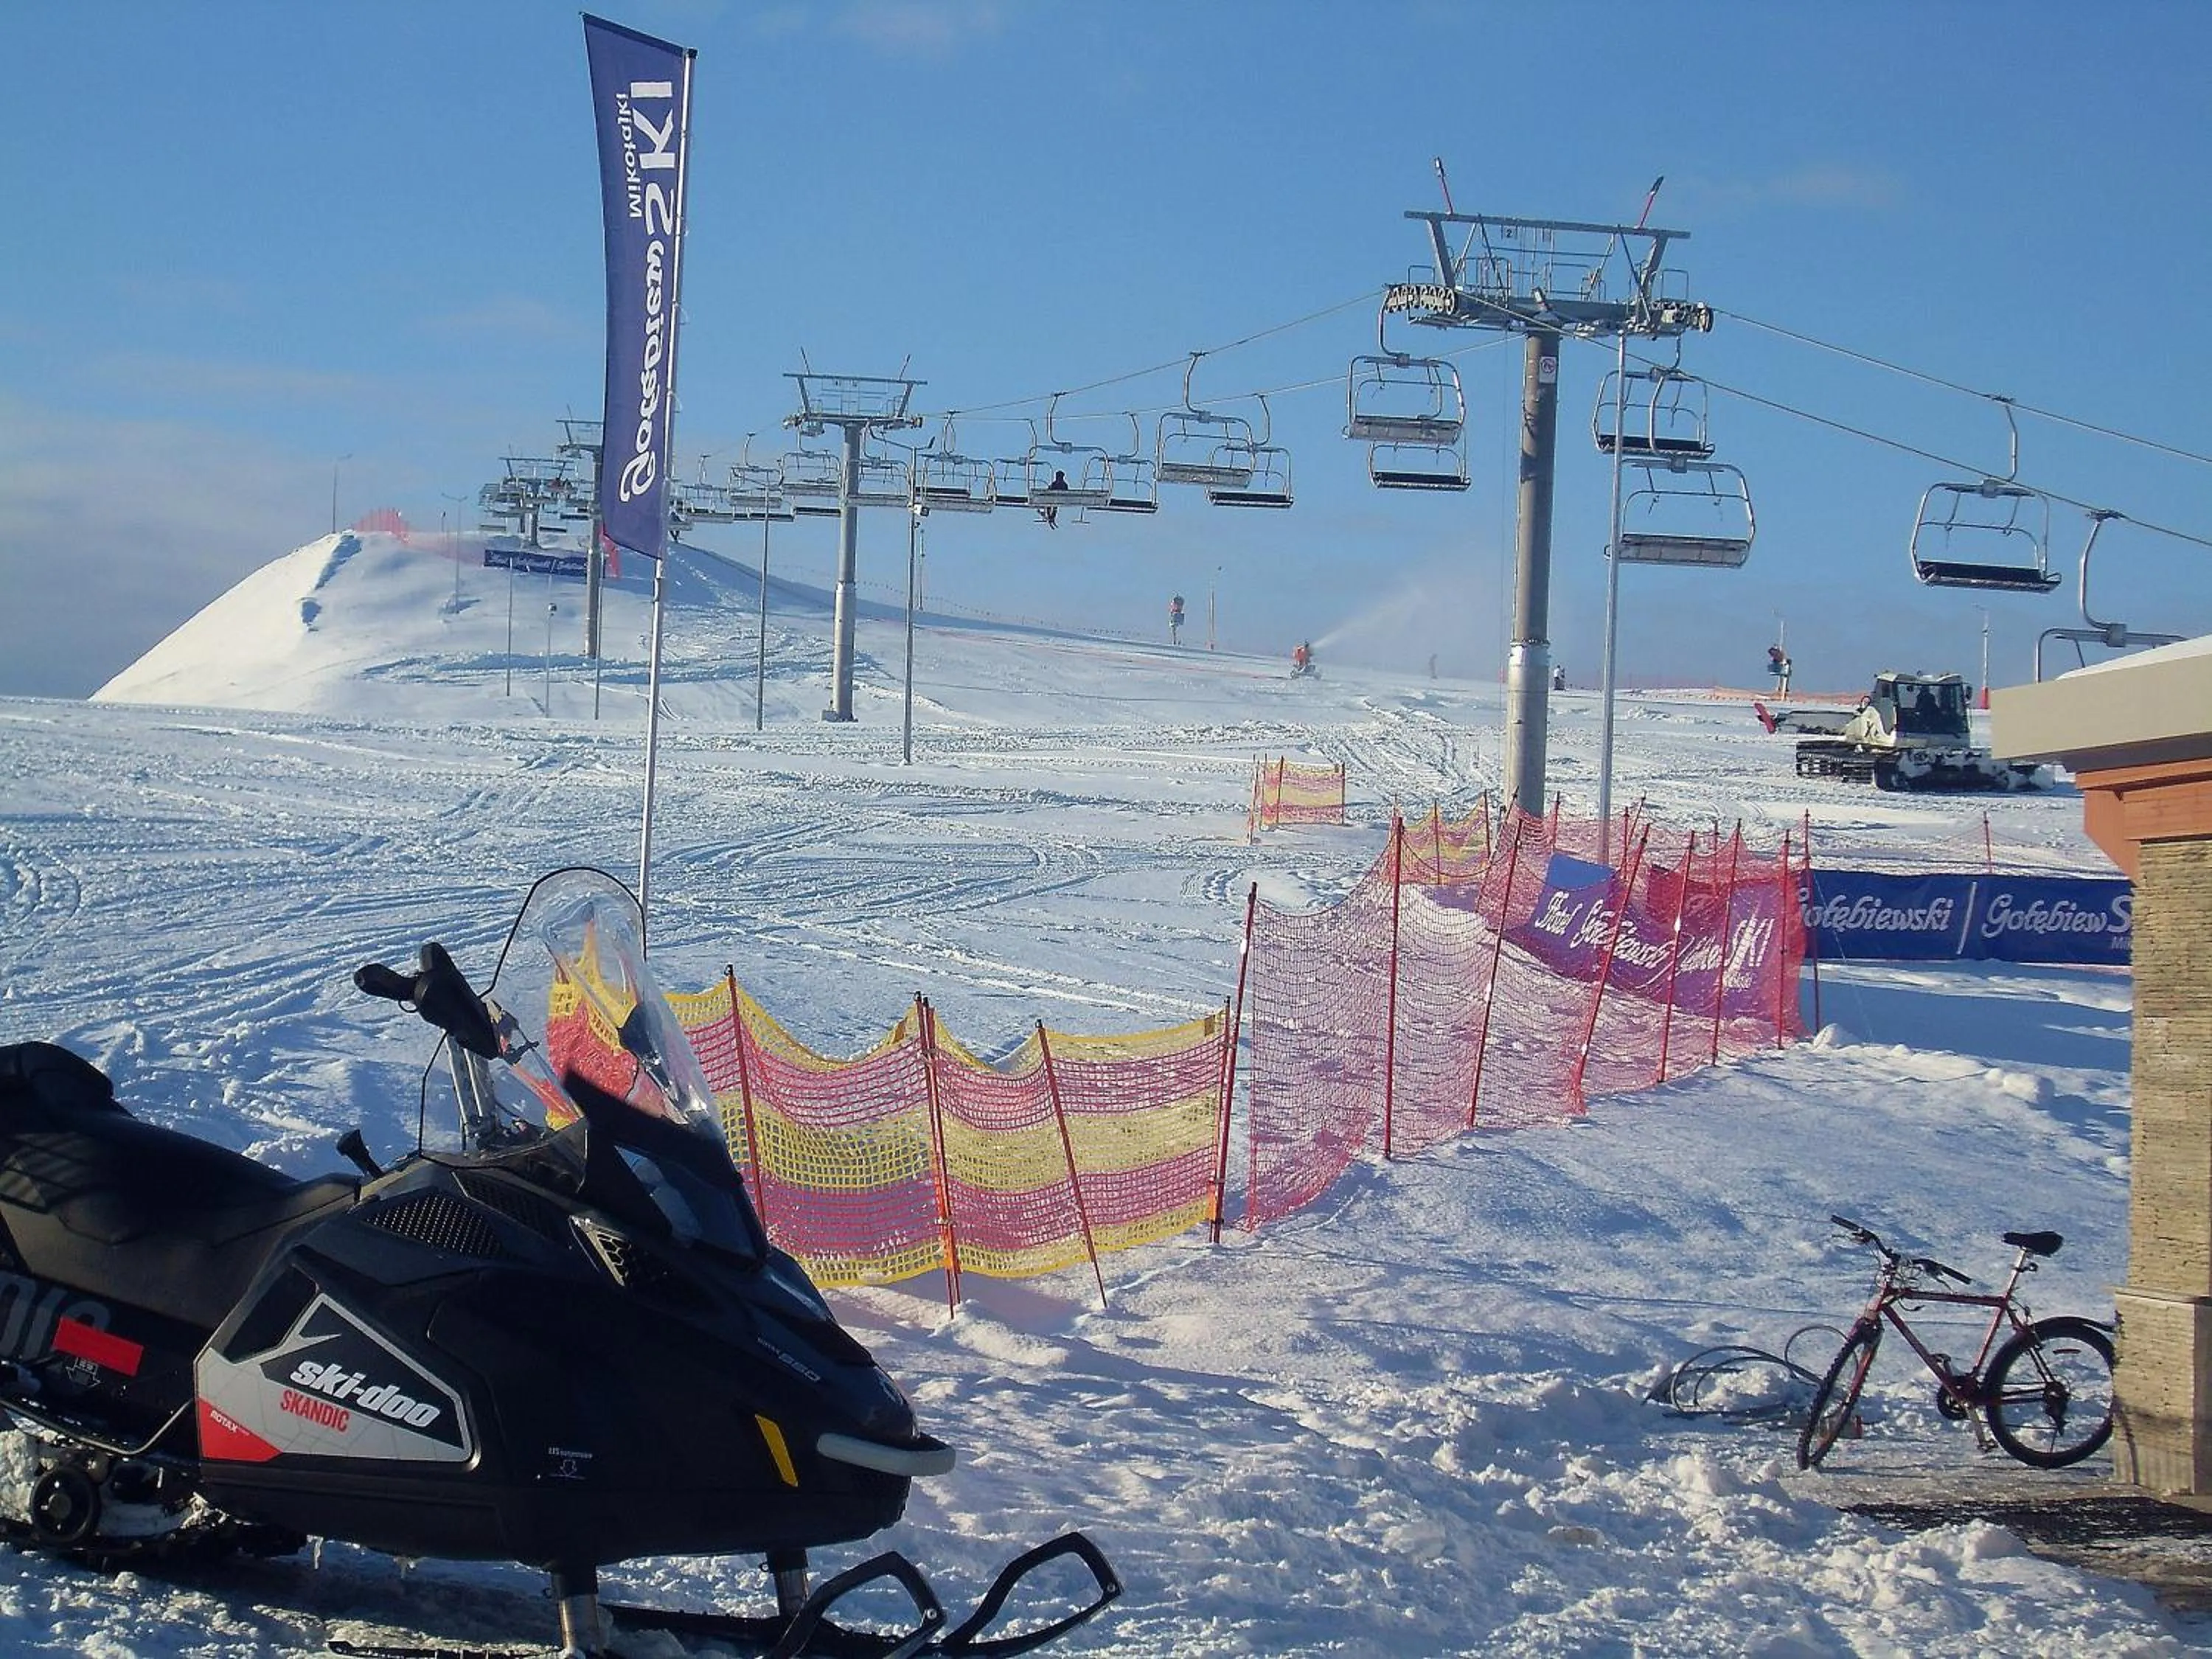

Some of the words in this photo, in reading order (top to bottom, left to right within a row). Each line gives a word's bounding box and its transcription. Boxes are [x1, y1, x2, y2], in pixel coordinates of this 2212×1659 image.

[1981, 894, 2132, 939] GołębiewS
[279, 1388, 351, 1433] SKANDIC
[290, 1358, 442, 1429] ski-doo
[209, 1409, 239, 1434] ROTAX
